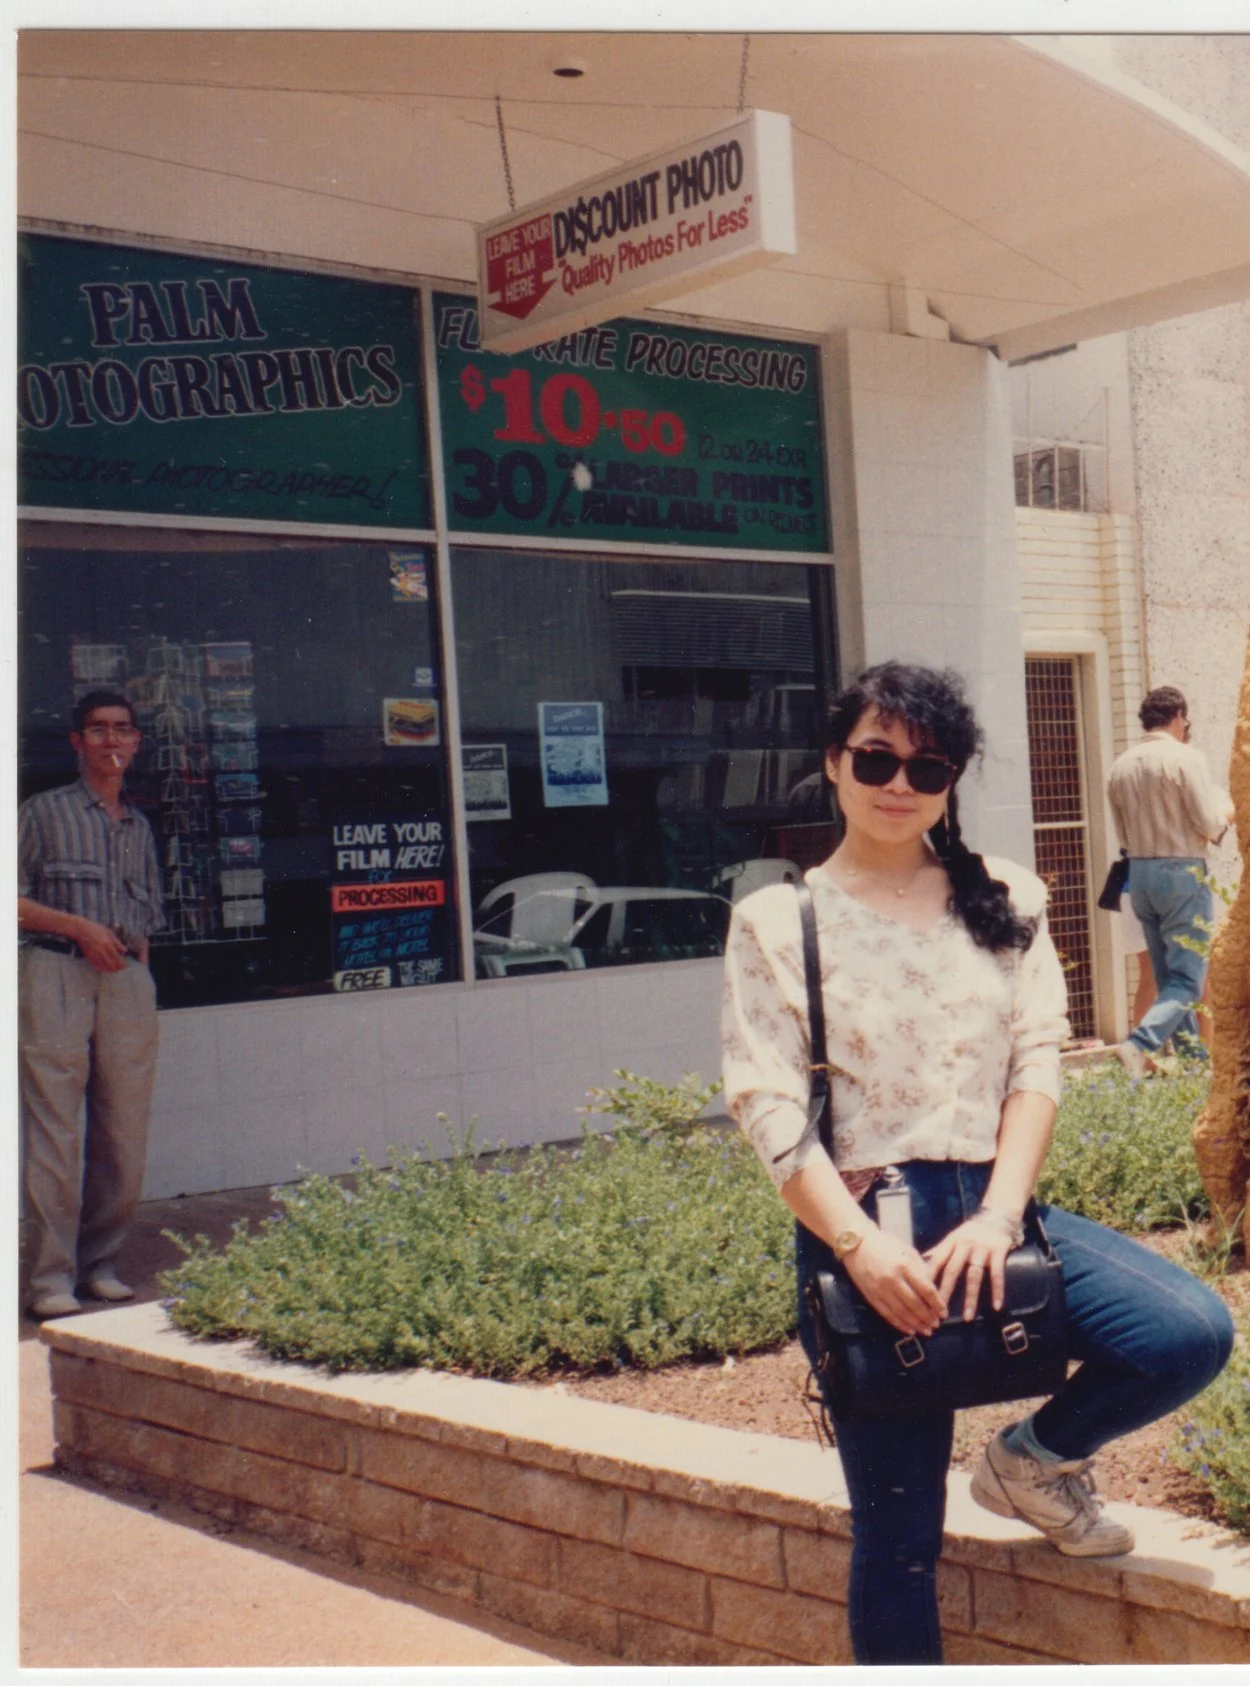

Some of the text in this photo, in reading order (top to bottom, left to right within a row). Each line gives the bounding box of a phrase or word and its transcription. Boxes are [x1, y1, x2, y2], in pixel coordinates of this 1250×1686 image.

[665, 139, 744, 214] PHOTO
[488, 217, 551, 261] LEAVE YOUR
[617, 233, 675, 274] Photos
[676, 219, 705, 252] For
[504, 249, 536, 279] FILM
[504, 275, 536, 304] HERE
[81, 278, 268, 348] PALM
[438, 306, 485, 353] FL
[625, 332, 808, 394] PROCESSING
[17, 345, 402, 431] OTOGRAPHICS
[712, 470, 814, 510] PRINTS
[332, 820, 443, 847] LEAVE YOUR
[336, 843, 446, 872] FILM HERE!
[338, 883, 438, 907] PROCESSING
[340, 969, 386, 991] FREE
